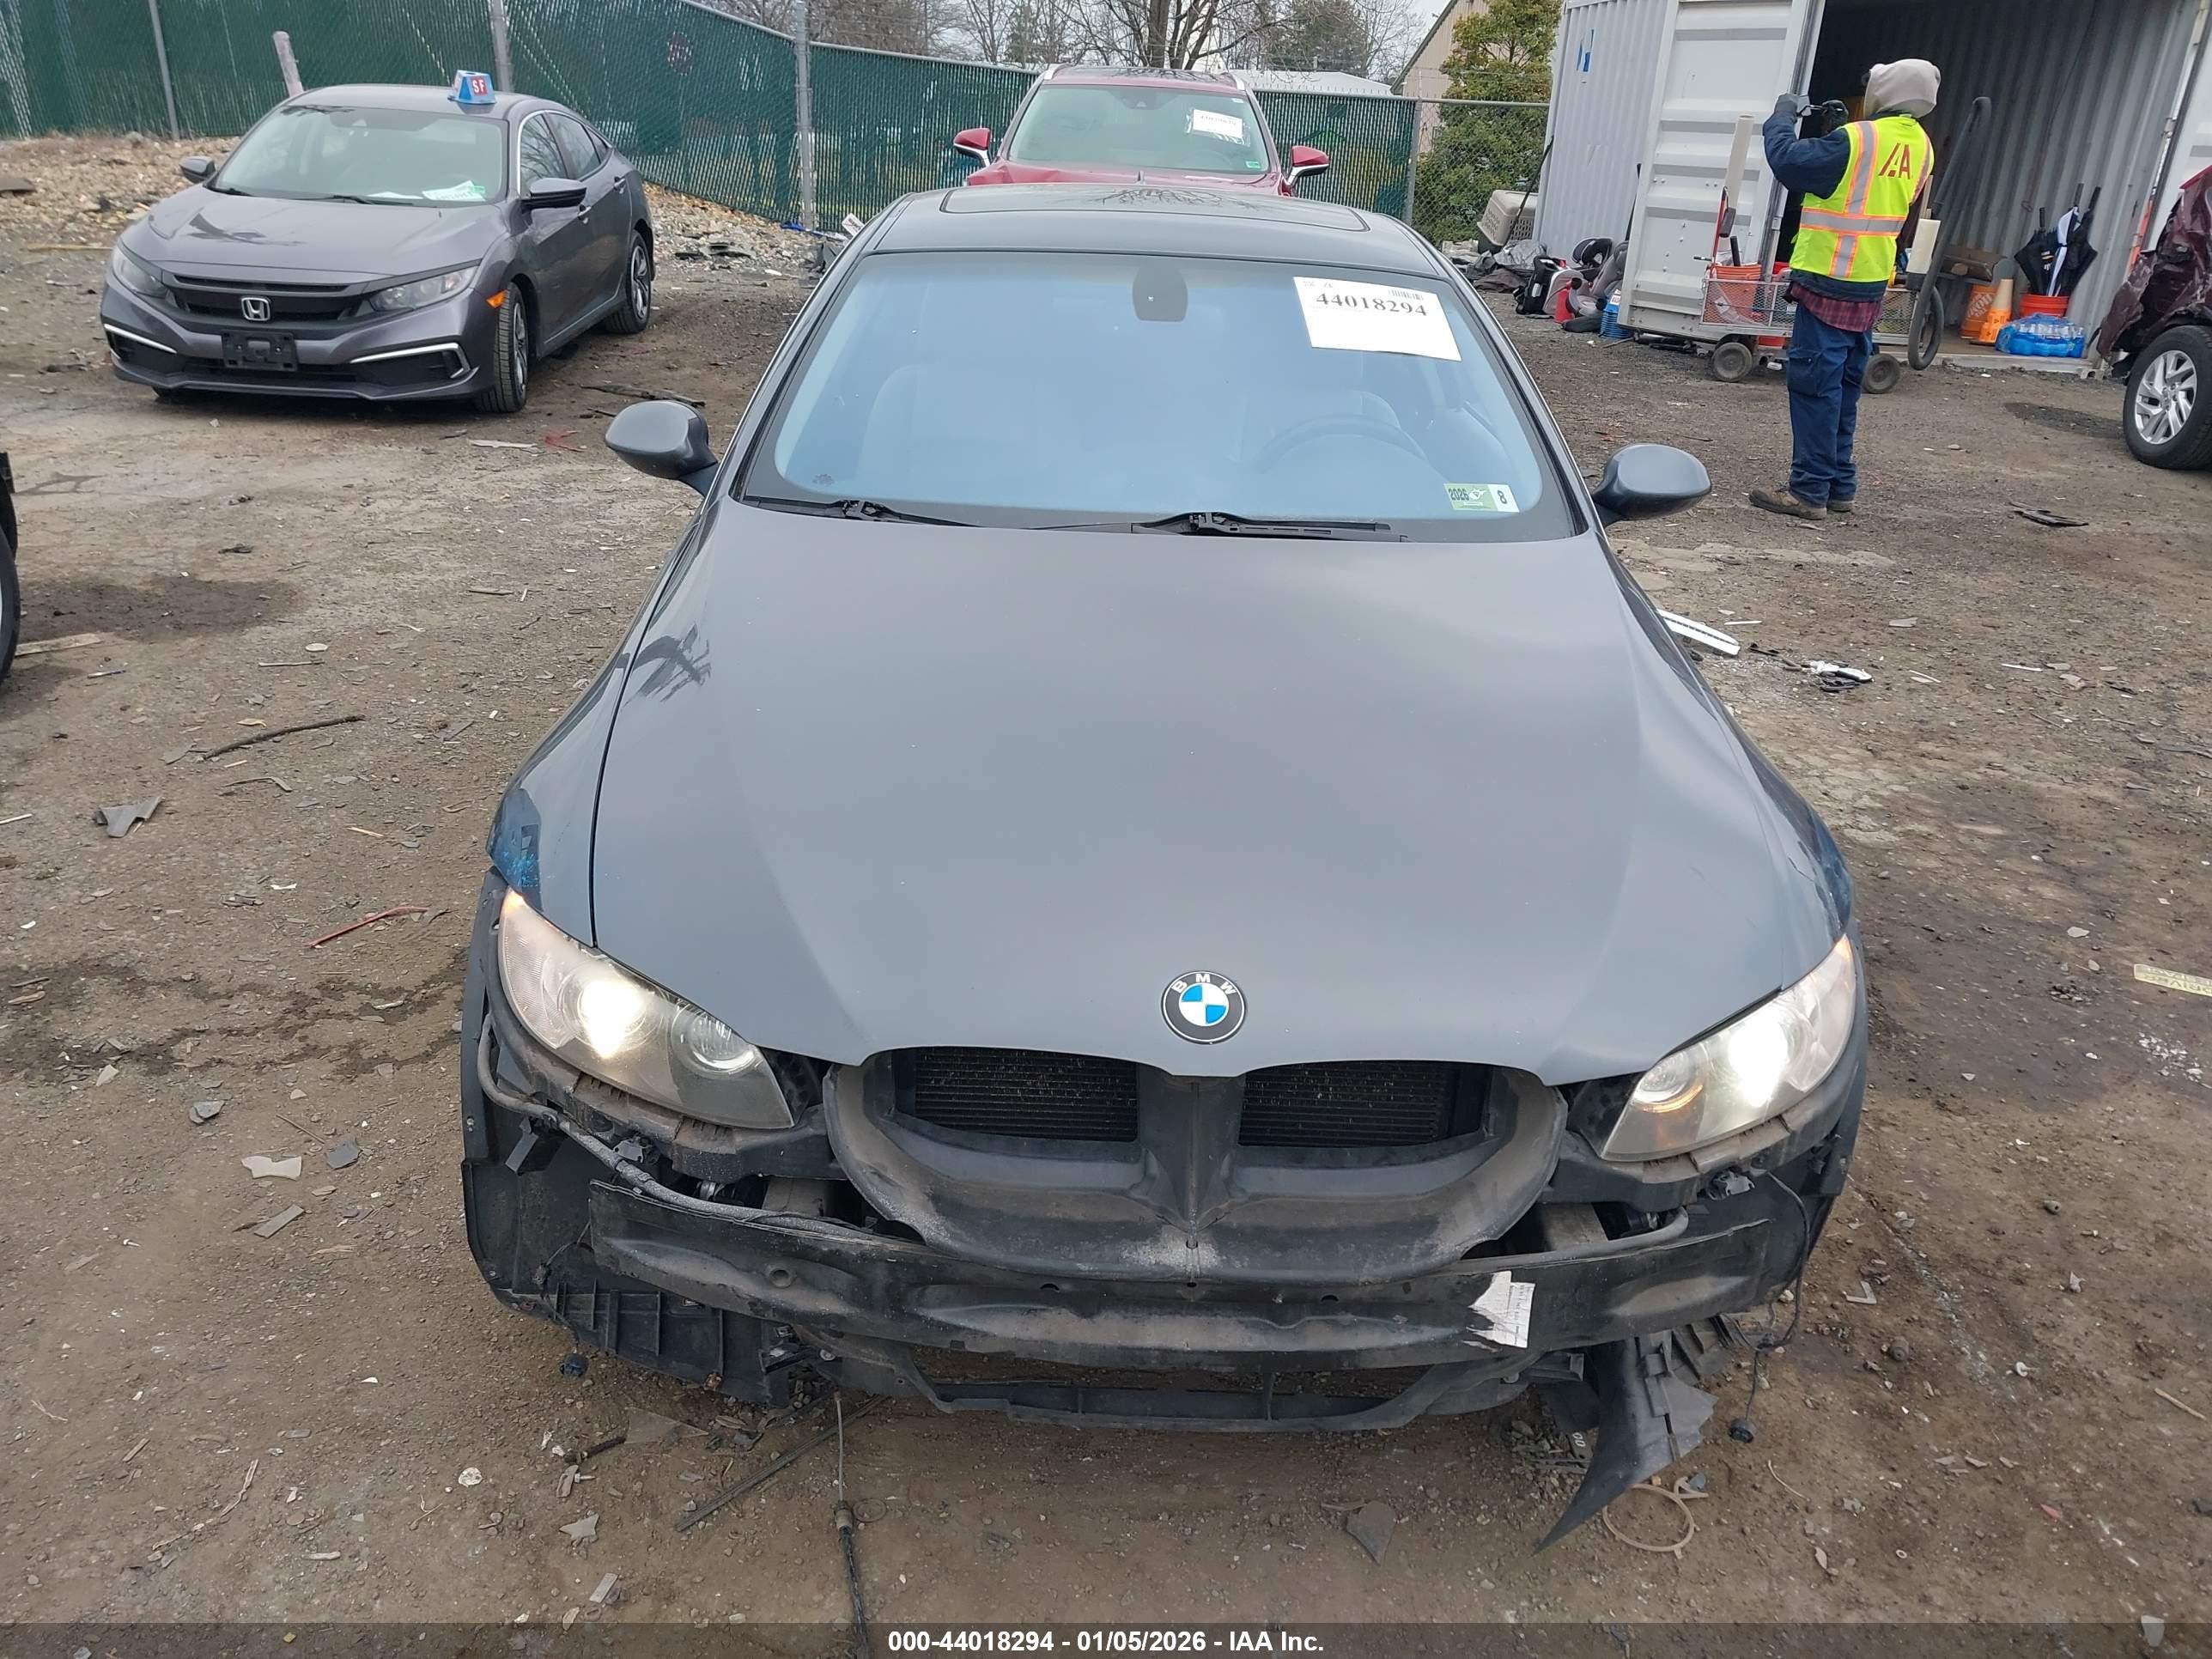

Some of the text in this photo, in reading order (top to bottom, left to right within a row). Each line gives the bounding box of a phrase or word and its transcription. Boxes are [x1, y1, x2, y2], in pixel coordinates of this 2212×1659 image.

[1316, 293, 1428, 316] 44018294
[1497, 489, 1508, 504] 8
[1171, 973, 1237, 994] BMW
